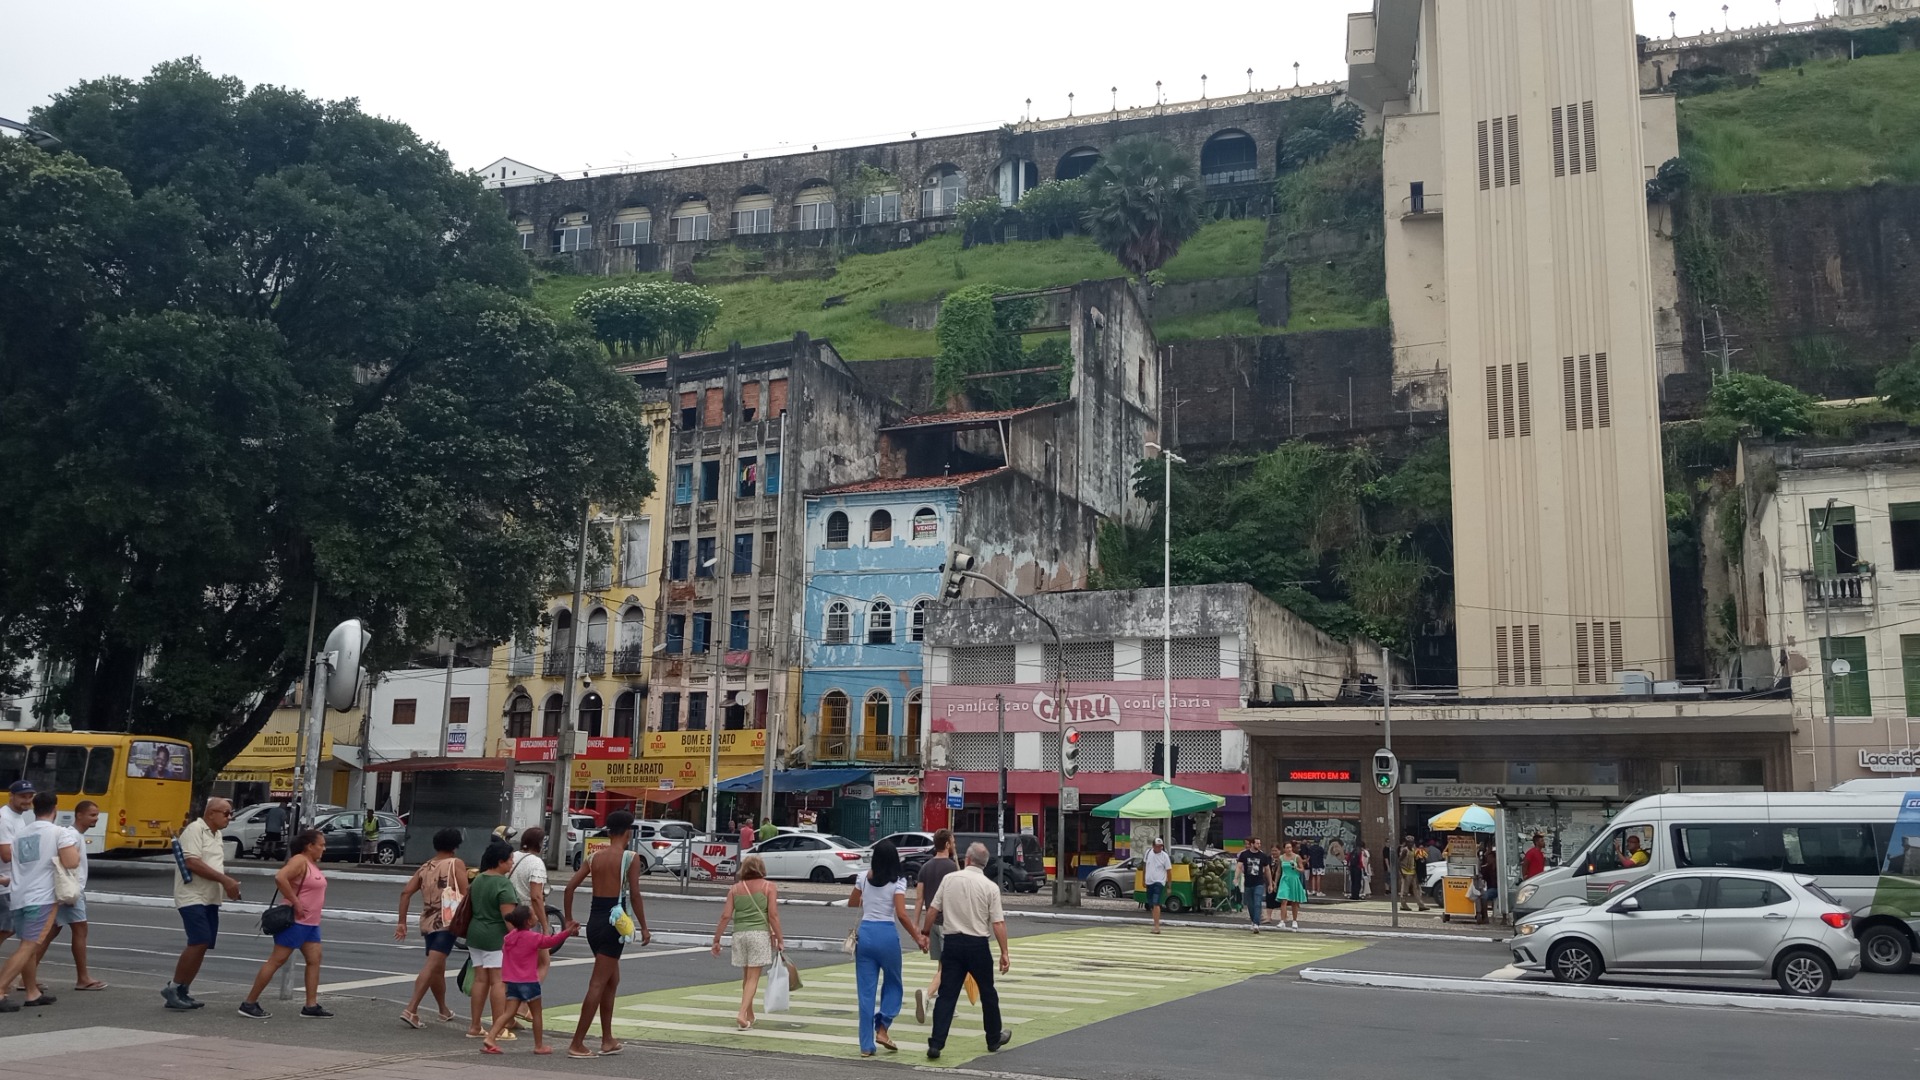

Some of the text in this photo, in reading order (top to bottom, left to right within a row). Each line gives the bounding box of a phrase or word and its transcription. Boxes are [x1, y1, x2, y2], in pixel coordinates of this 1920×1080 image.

[1124, 693, 1210, 711] confetaria
[264, 736, 289, 746] MODELO
[681, 734, 736, 745] BOM E BRATO
[607, 763, 664, 775] BOM E BARATO
[1327, 772, 1338, 780] EM
[1340, 772, 1350, 780] 3X
[1425, 786, 1505, 797] ELEVADOR
[1294, 820, 1313, 829] SUA
[703, 845, 727, 857] LUPA
